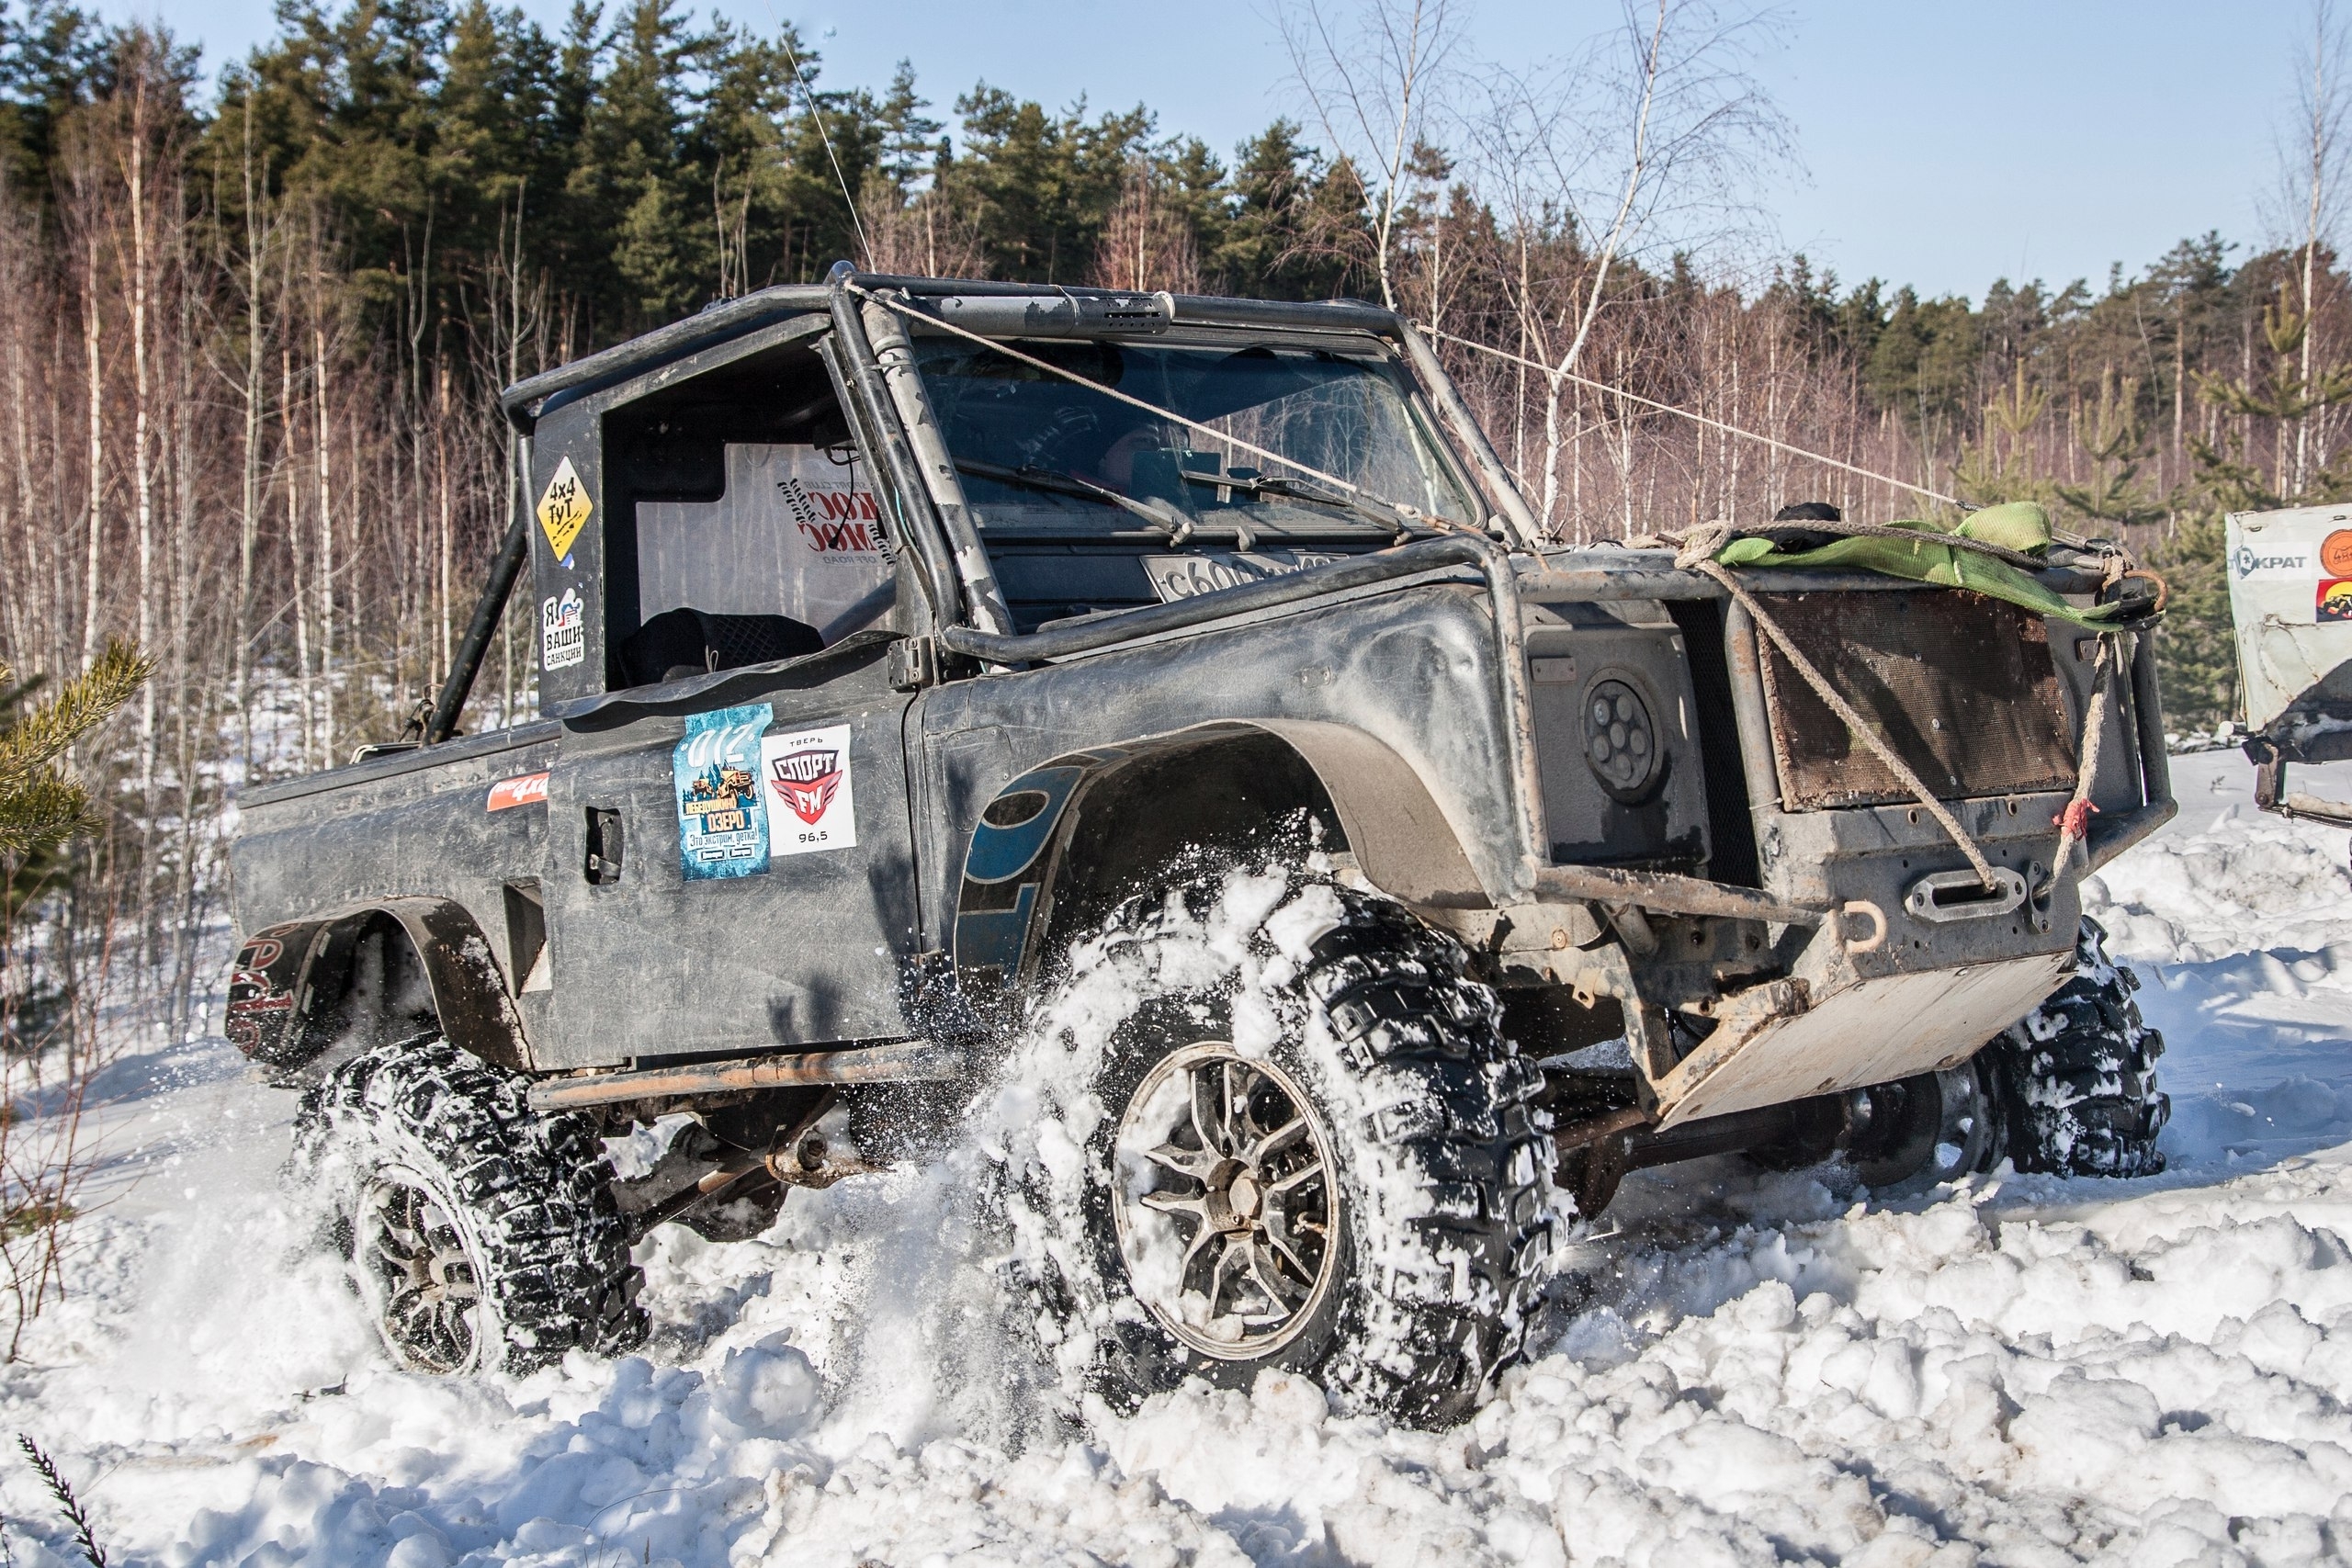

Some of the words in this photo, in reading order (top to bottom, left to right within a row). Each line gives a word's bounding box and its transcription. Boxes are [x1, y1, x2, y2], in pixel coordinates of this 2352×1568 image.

[549, 477, 576, 501] 4x4
[546, 626, 582, 651] ВАШИ
[546, 646, 582, 666] САНКЦИИ
[790, 738, 823, 747] ТВЕРЬ
[775, 752, 835, 781] СПОРТ
[794, 784, 824, 816] FM
[707, 809, 745, 832] ОЗЕРО
[690, 834, 703, 847] Это
[798, 831, 828, 842] 96,5
